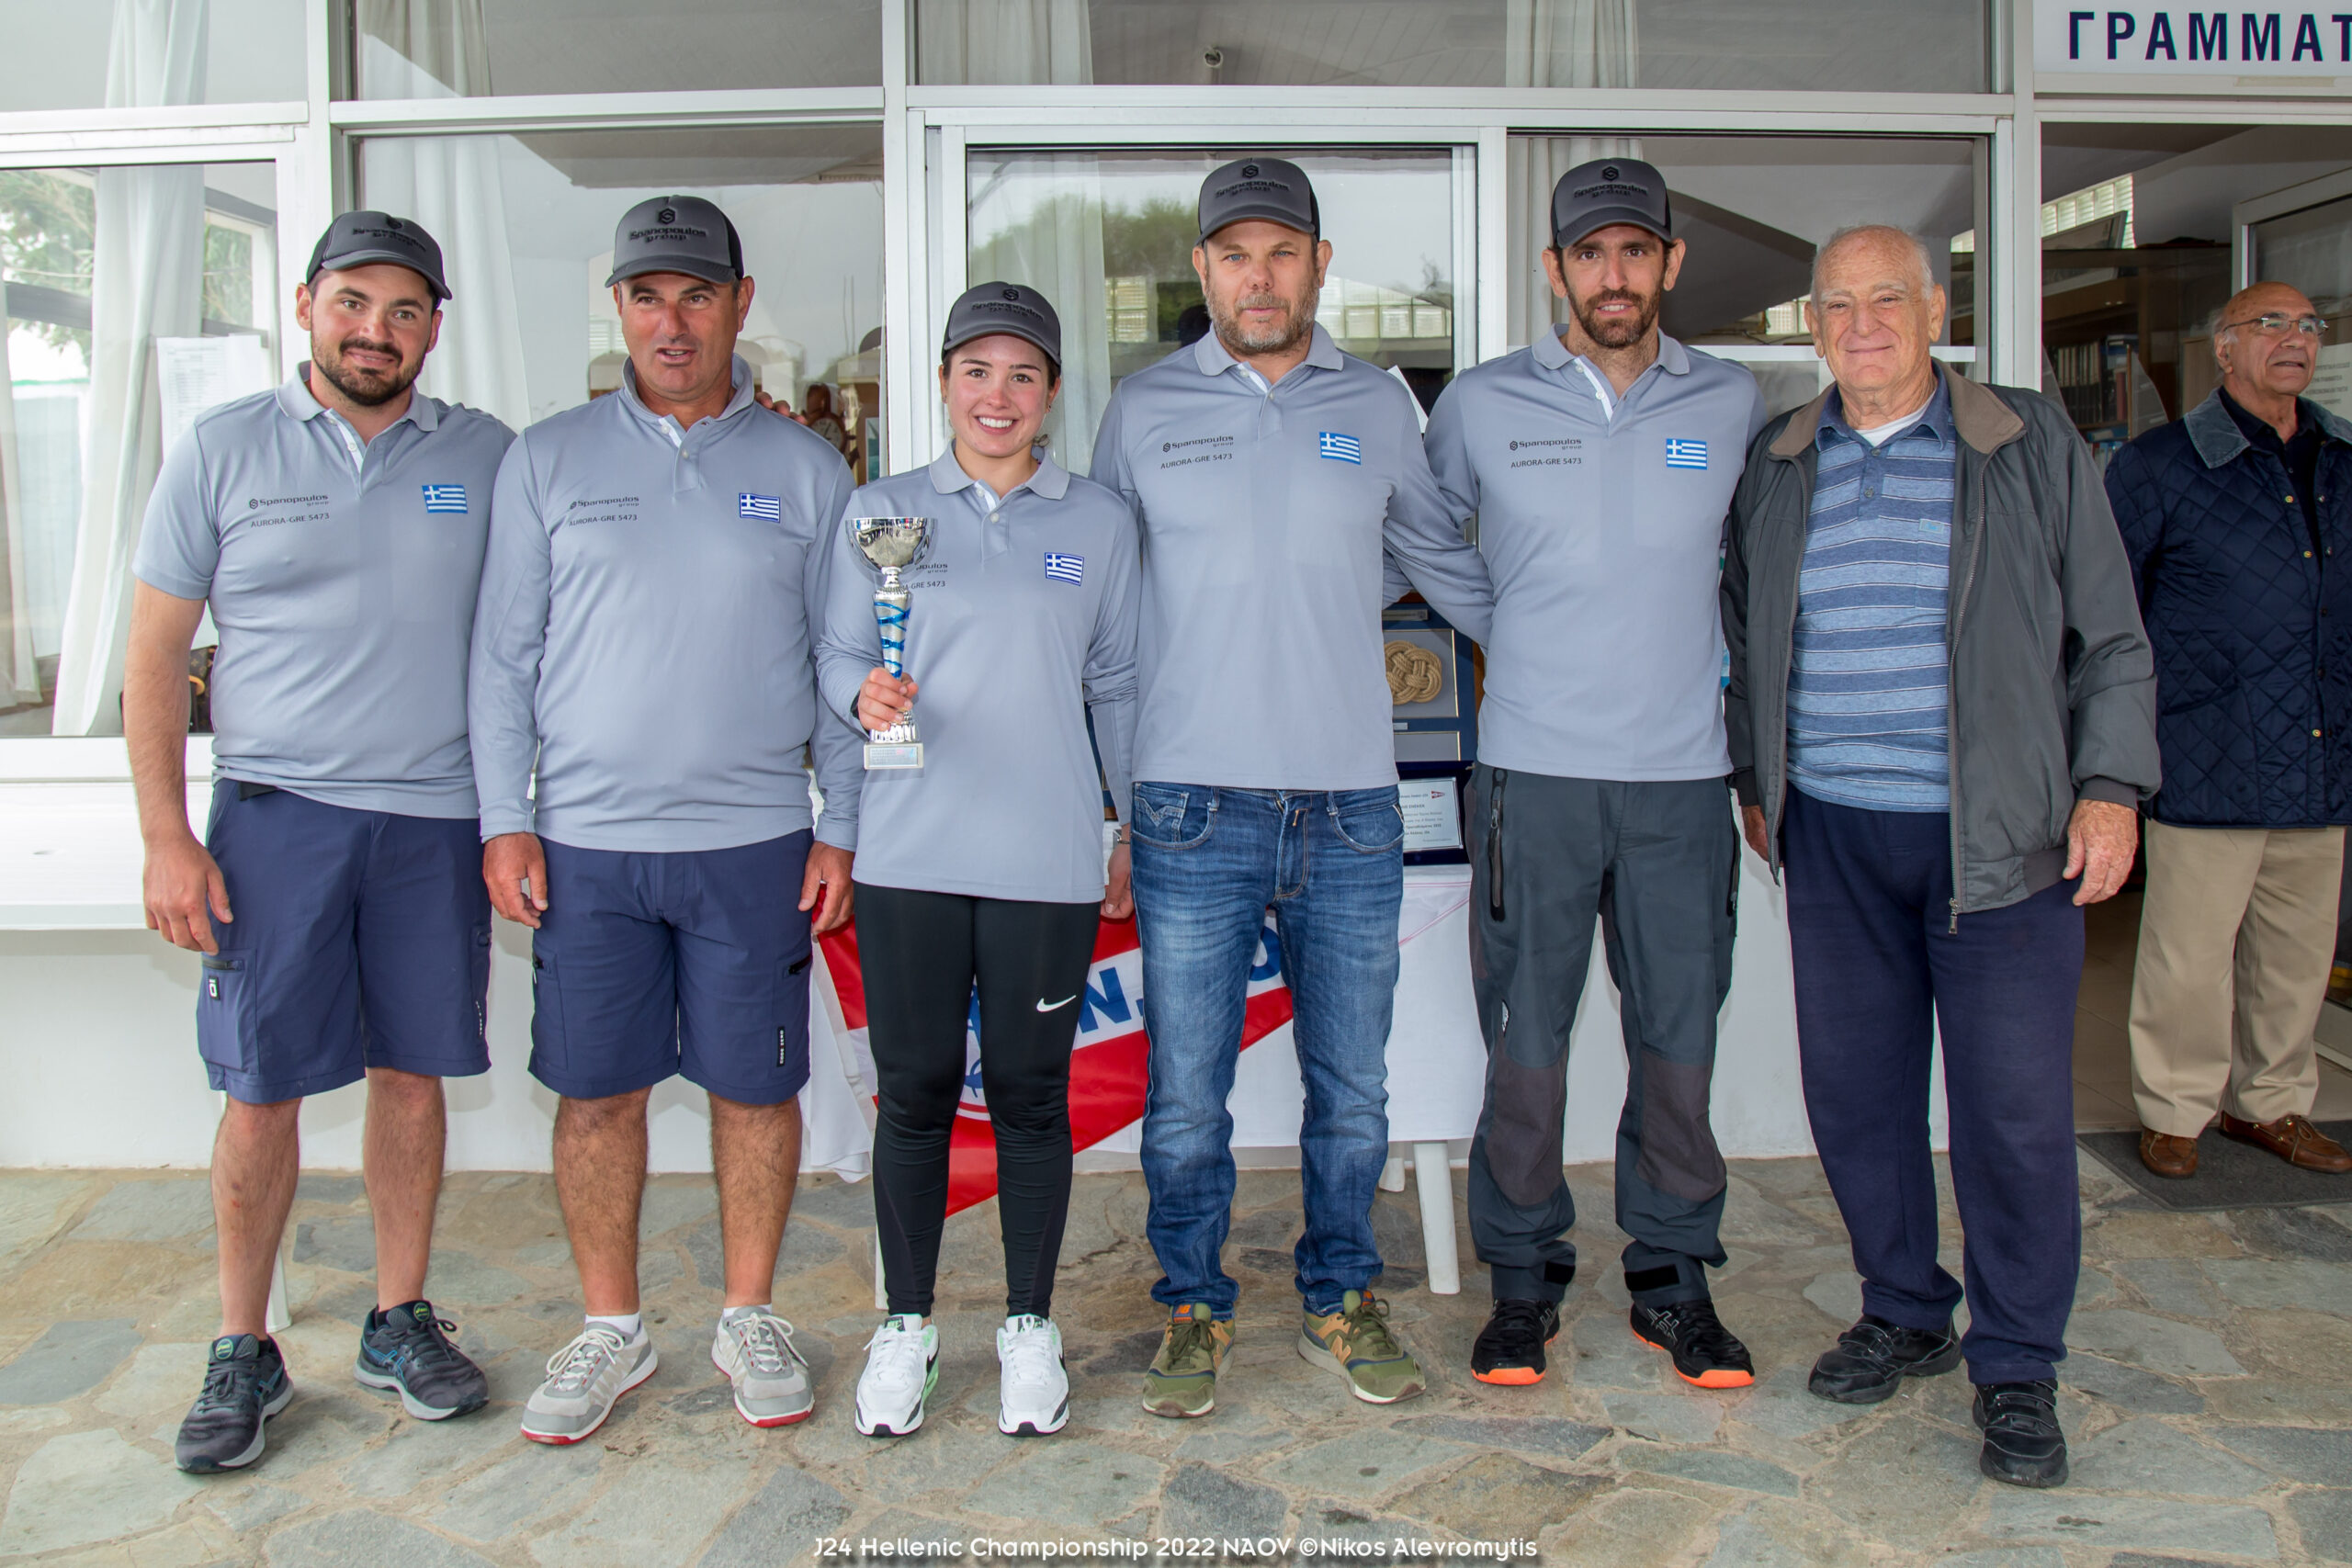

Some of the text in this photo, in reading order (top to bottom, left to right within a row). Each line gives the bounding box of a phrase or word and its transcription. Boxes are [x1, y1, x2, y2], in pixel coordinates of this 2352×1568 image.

[1171, 435, 1234, 449] Spanopoulos
[1519, 438, 1582, 449] Spanopoulos
[1160, 453, 1233, 470] AURORA-GRE 5473
[1510, 458, 1561, 468] AURORA-GRE
[259, 494, 329, 507] Spanopoulos
[577, 496, 639, 508] Spanopoulos
[250, 513, 330, 528] AURORA-GRE 5473
